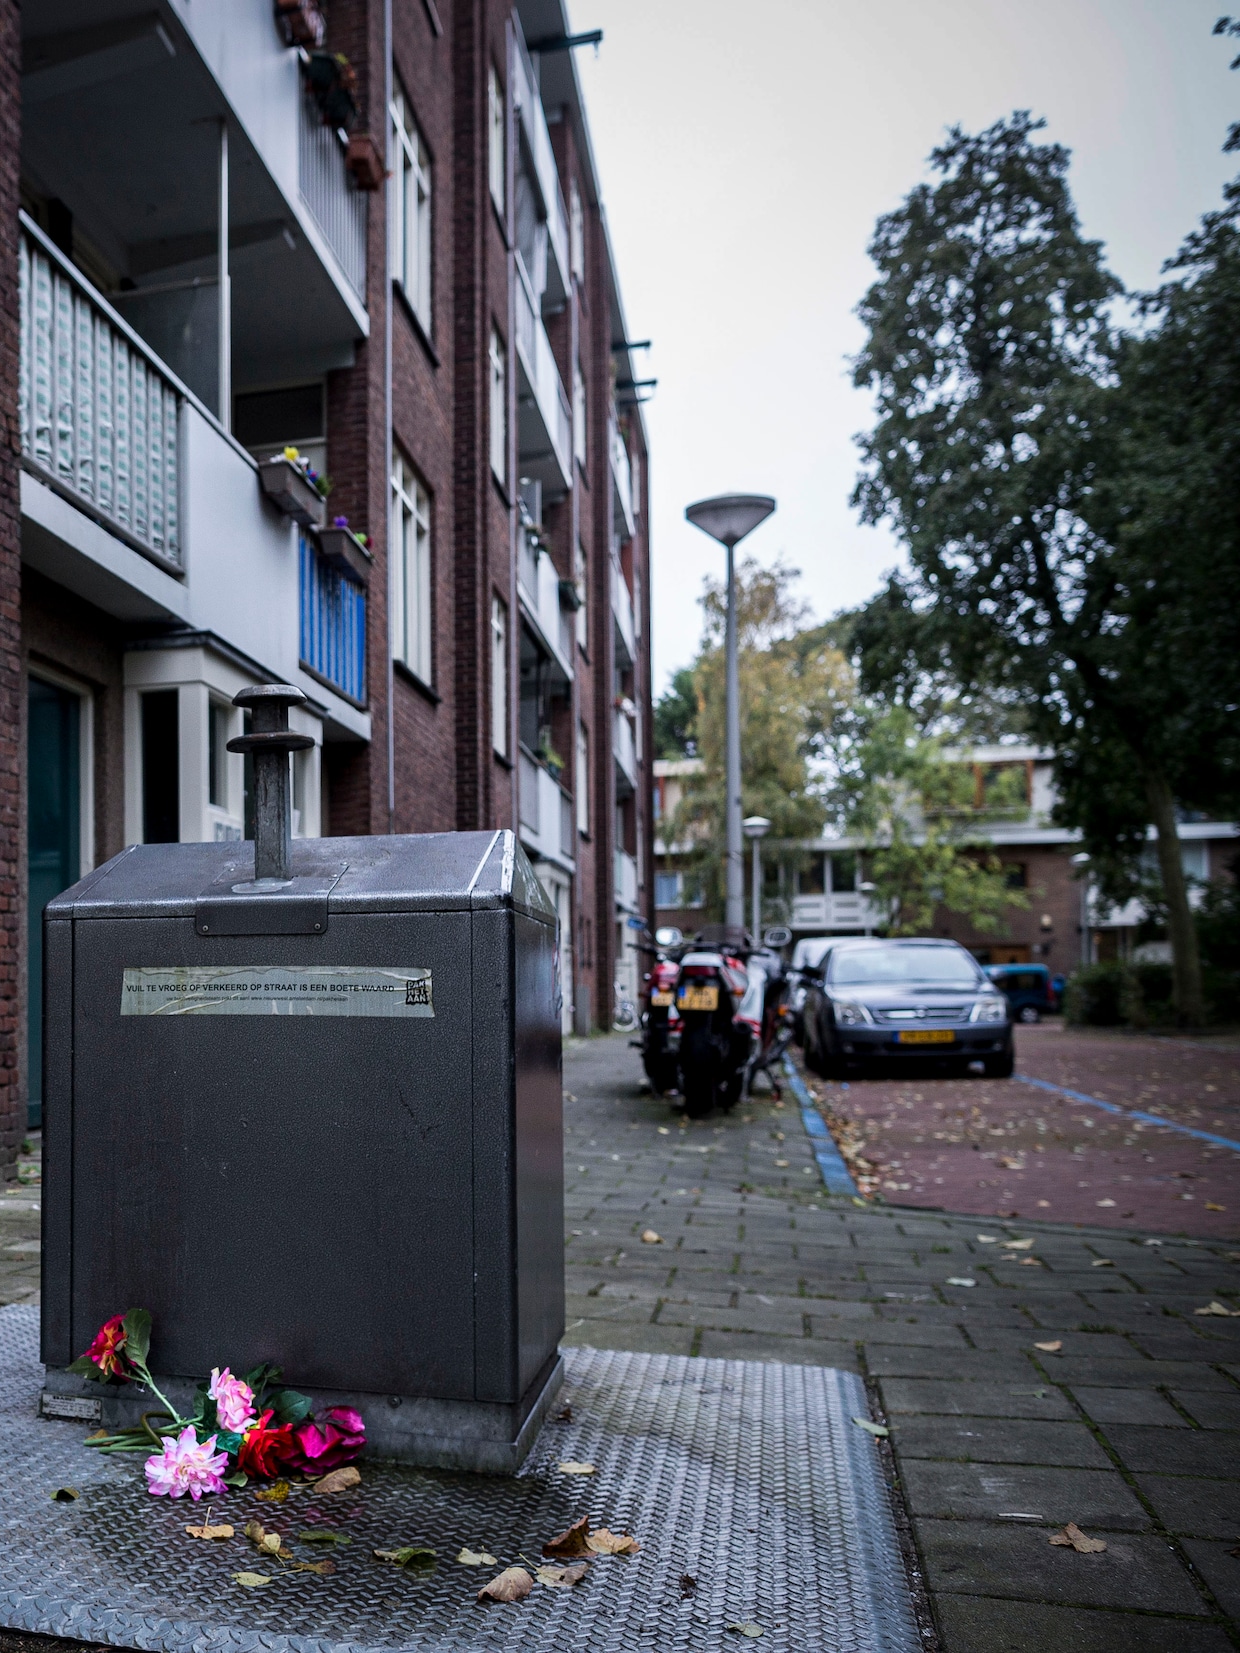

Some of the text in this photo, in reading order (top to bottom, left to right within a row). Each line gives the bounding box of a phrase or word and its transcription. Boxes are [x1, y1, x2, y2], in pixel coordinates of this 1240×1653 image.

[126, 983, 394, 992] VUIL TE VROEG OF VERKEERD OP STRAAT IS EEN BOETE WAARD
[407, 980, 425, 989] PAK
[407, 987, 425, 995] HET
